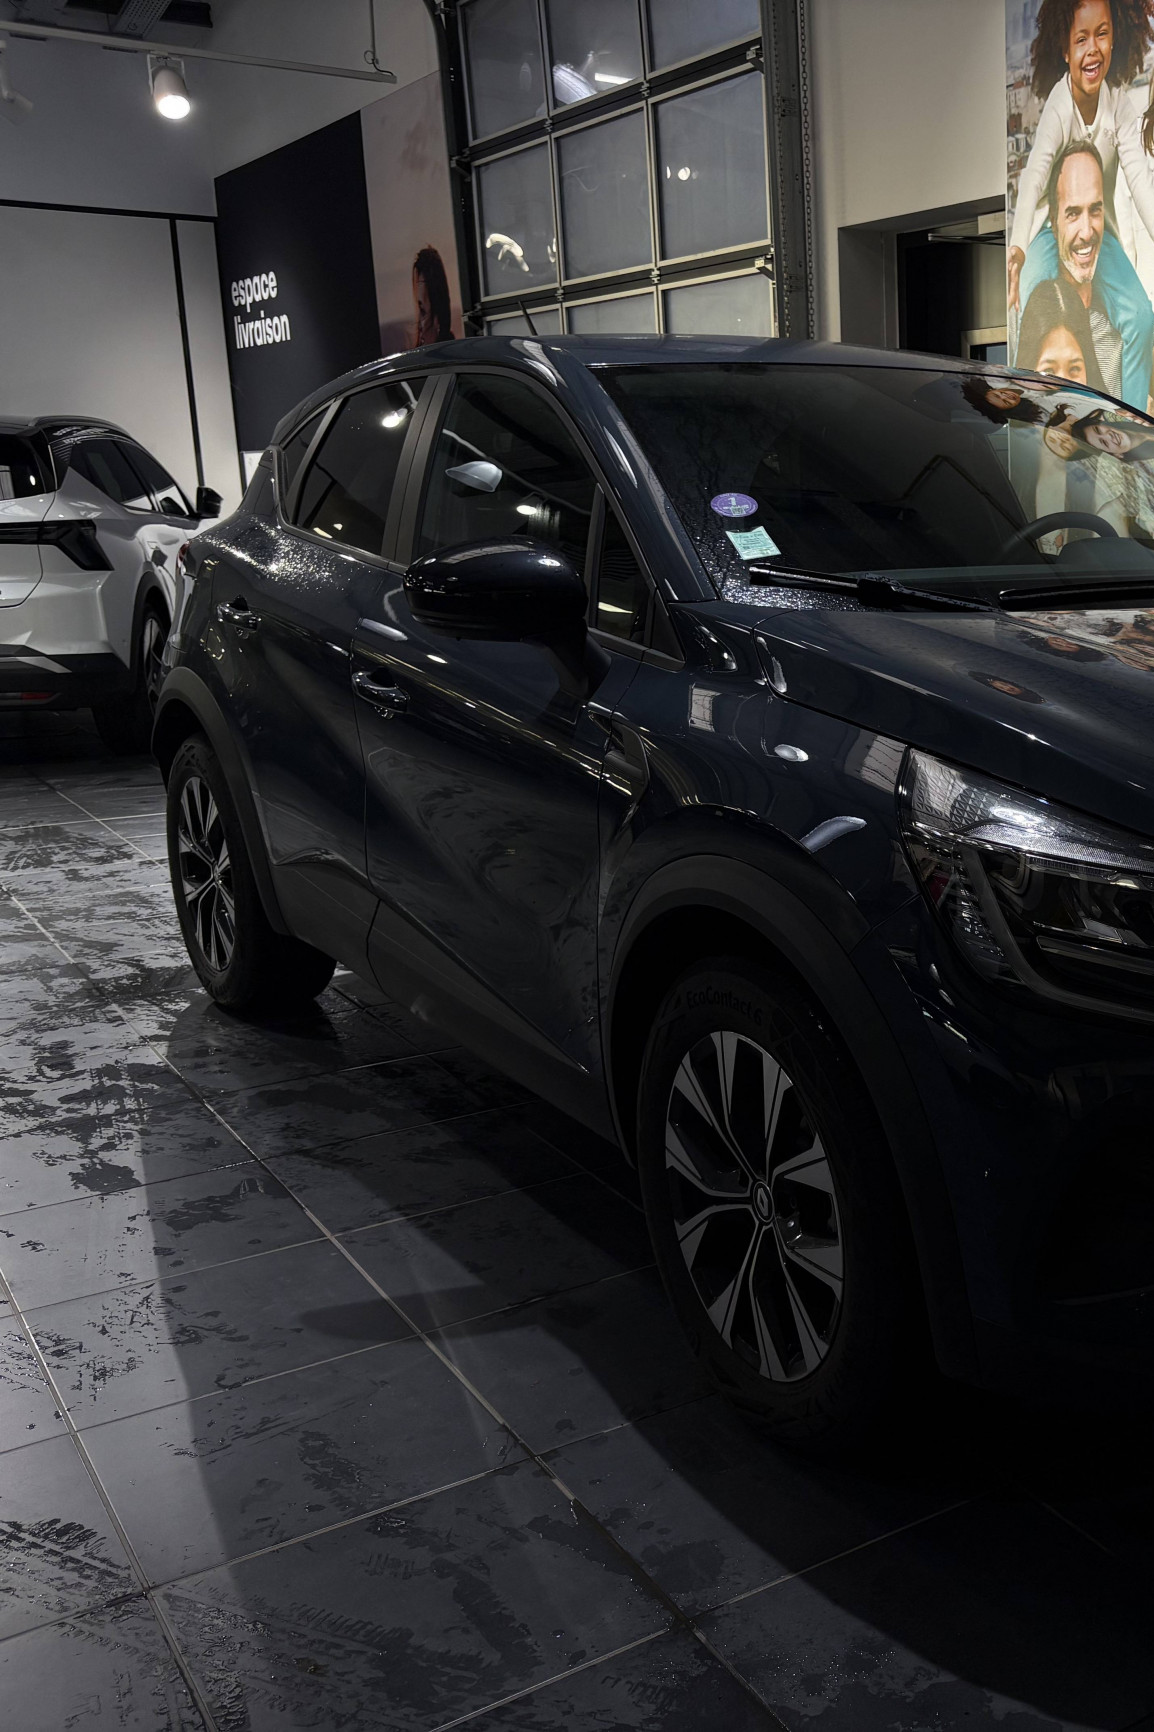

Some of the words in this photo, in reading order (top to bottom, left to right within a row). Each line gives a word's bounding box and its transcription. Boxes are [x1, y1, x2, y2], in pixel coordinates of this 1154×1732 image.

[231, 271, 277, 312] espace
[234, 310, 291, 349] livraison
[687, 986, 751, 1018] EcoContact
[754, 1008, 763, 1026] 6
